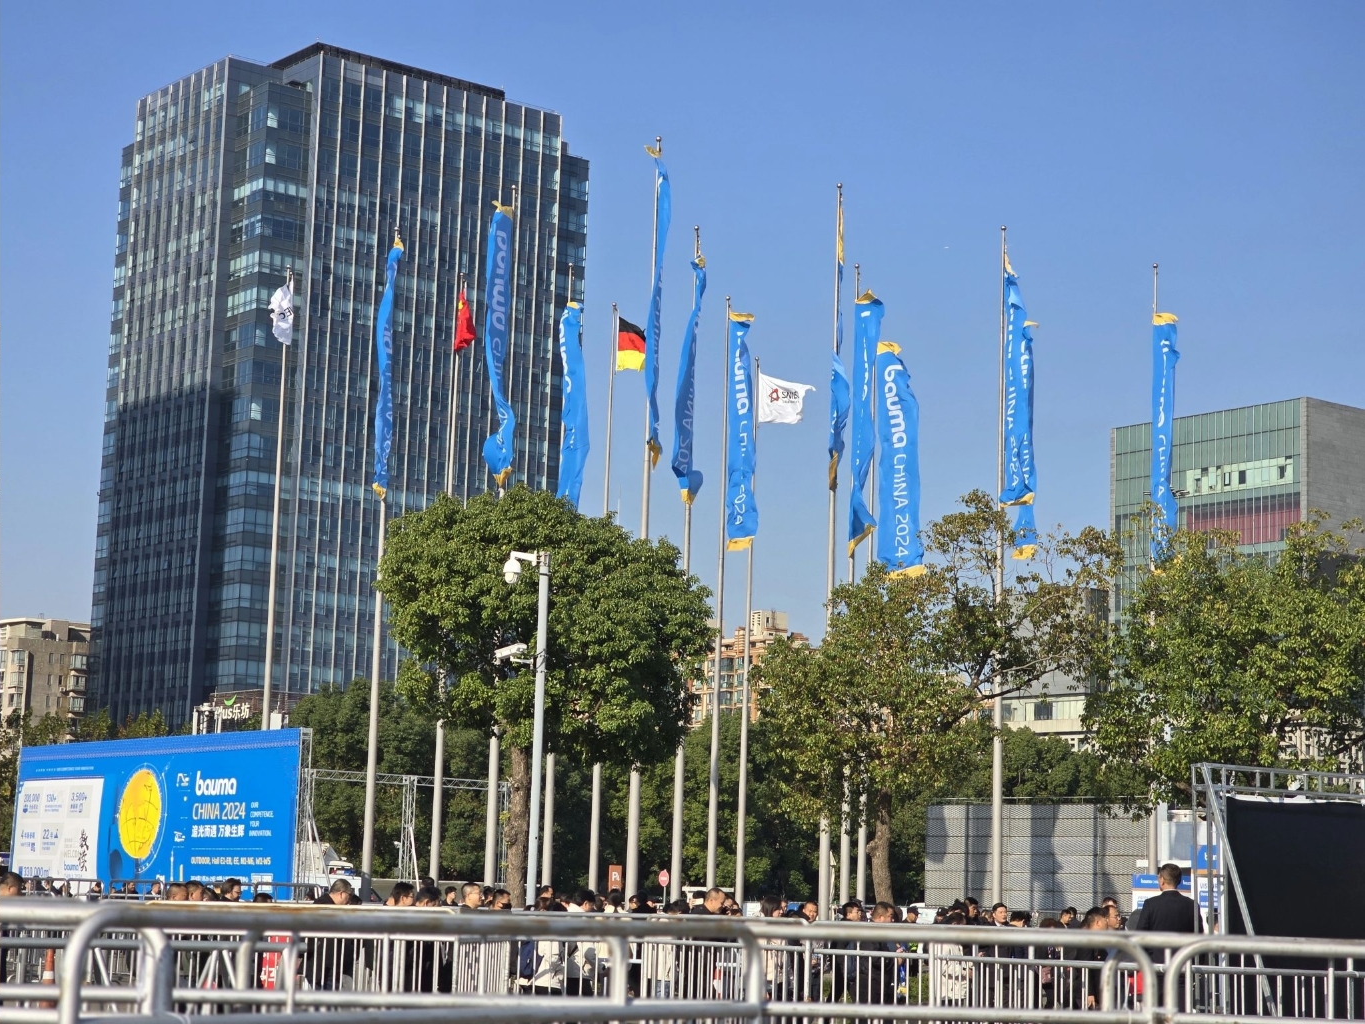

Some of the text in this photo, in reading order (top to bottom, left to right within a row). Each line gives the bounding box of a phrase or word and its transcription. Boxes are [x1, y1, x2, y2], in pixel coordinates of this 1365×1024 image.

[884, 365, 910, 558] bauma CHINA 2024
[195, 771, 237, 796] bauma
[192, 801, 246, 820] CHINA 2024
[191, 824, 245, 838] 追光而遇 万象生辉
